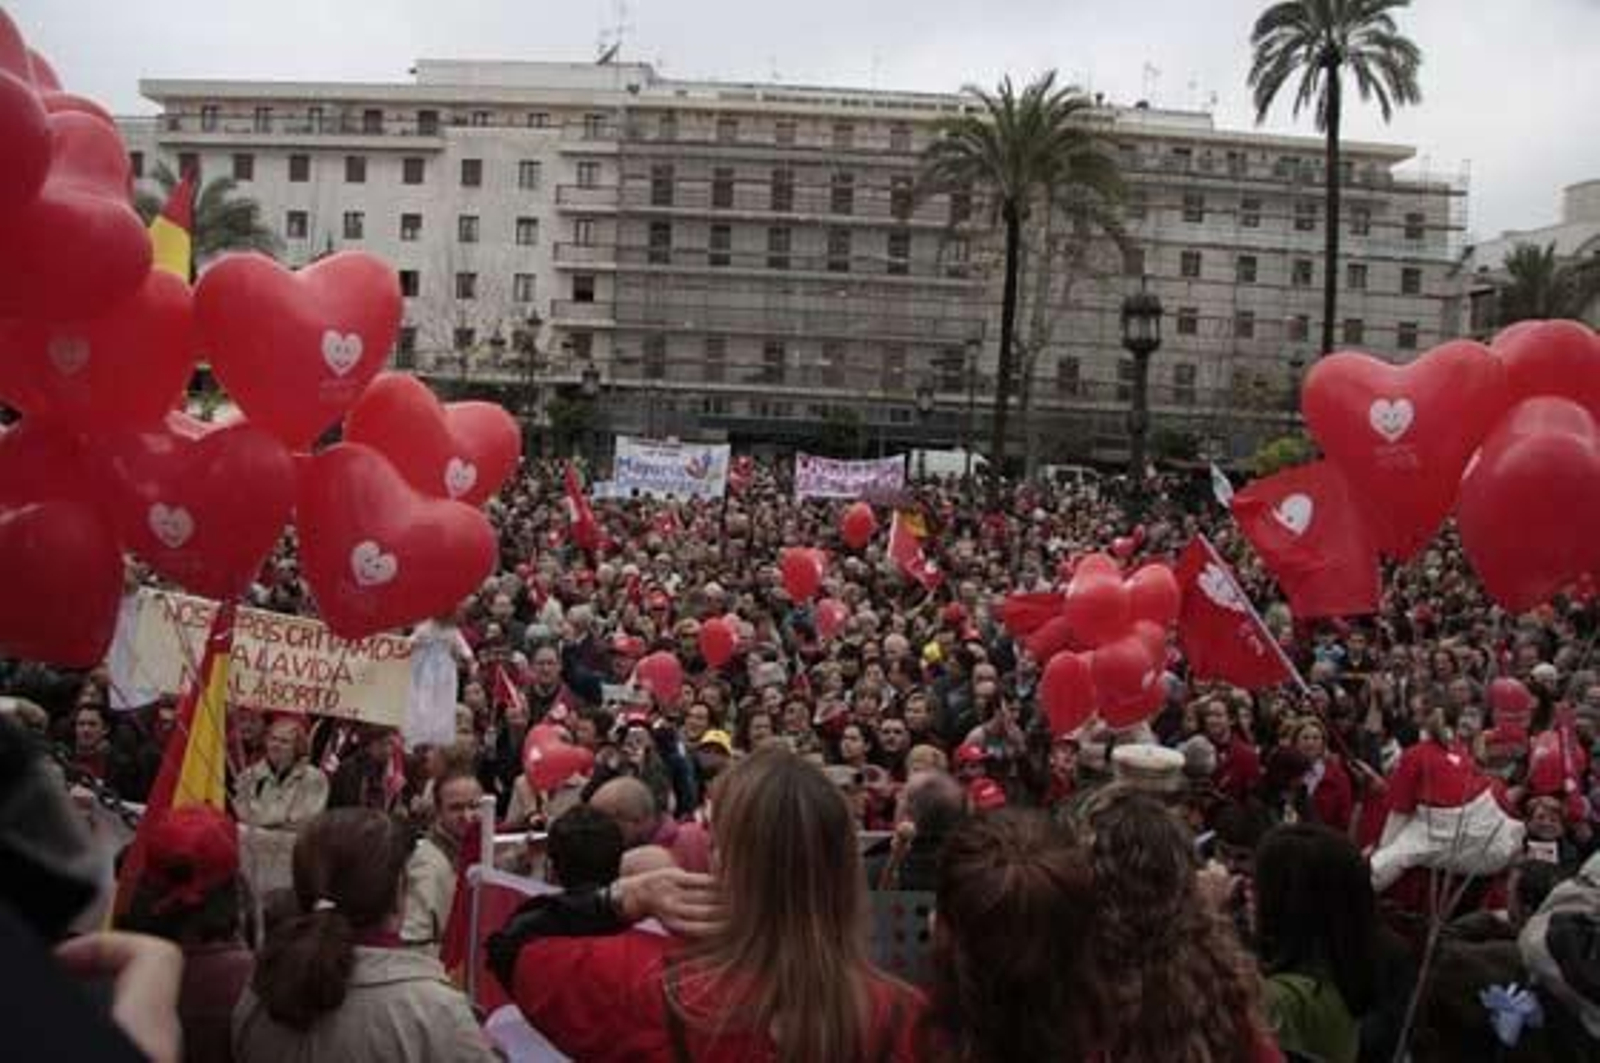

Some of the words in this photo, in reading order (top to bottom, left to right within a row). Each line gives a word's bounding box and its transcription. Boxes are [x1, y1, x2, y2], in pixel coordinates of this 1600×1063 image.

[230, 644, 250, 670] A
[254, 647, 289, 677] LA
[292, 653, 354, 686] VIDA
[253, 677, 340, 710] ABORTO
